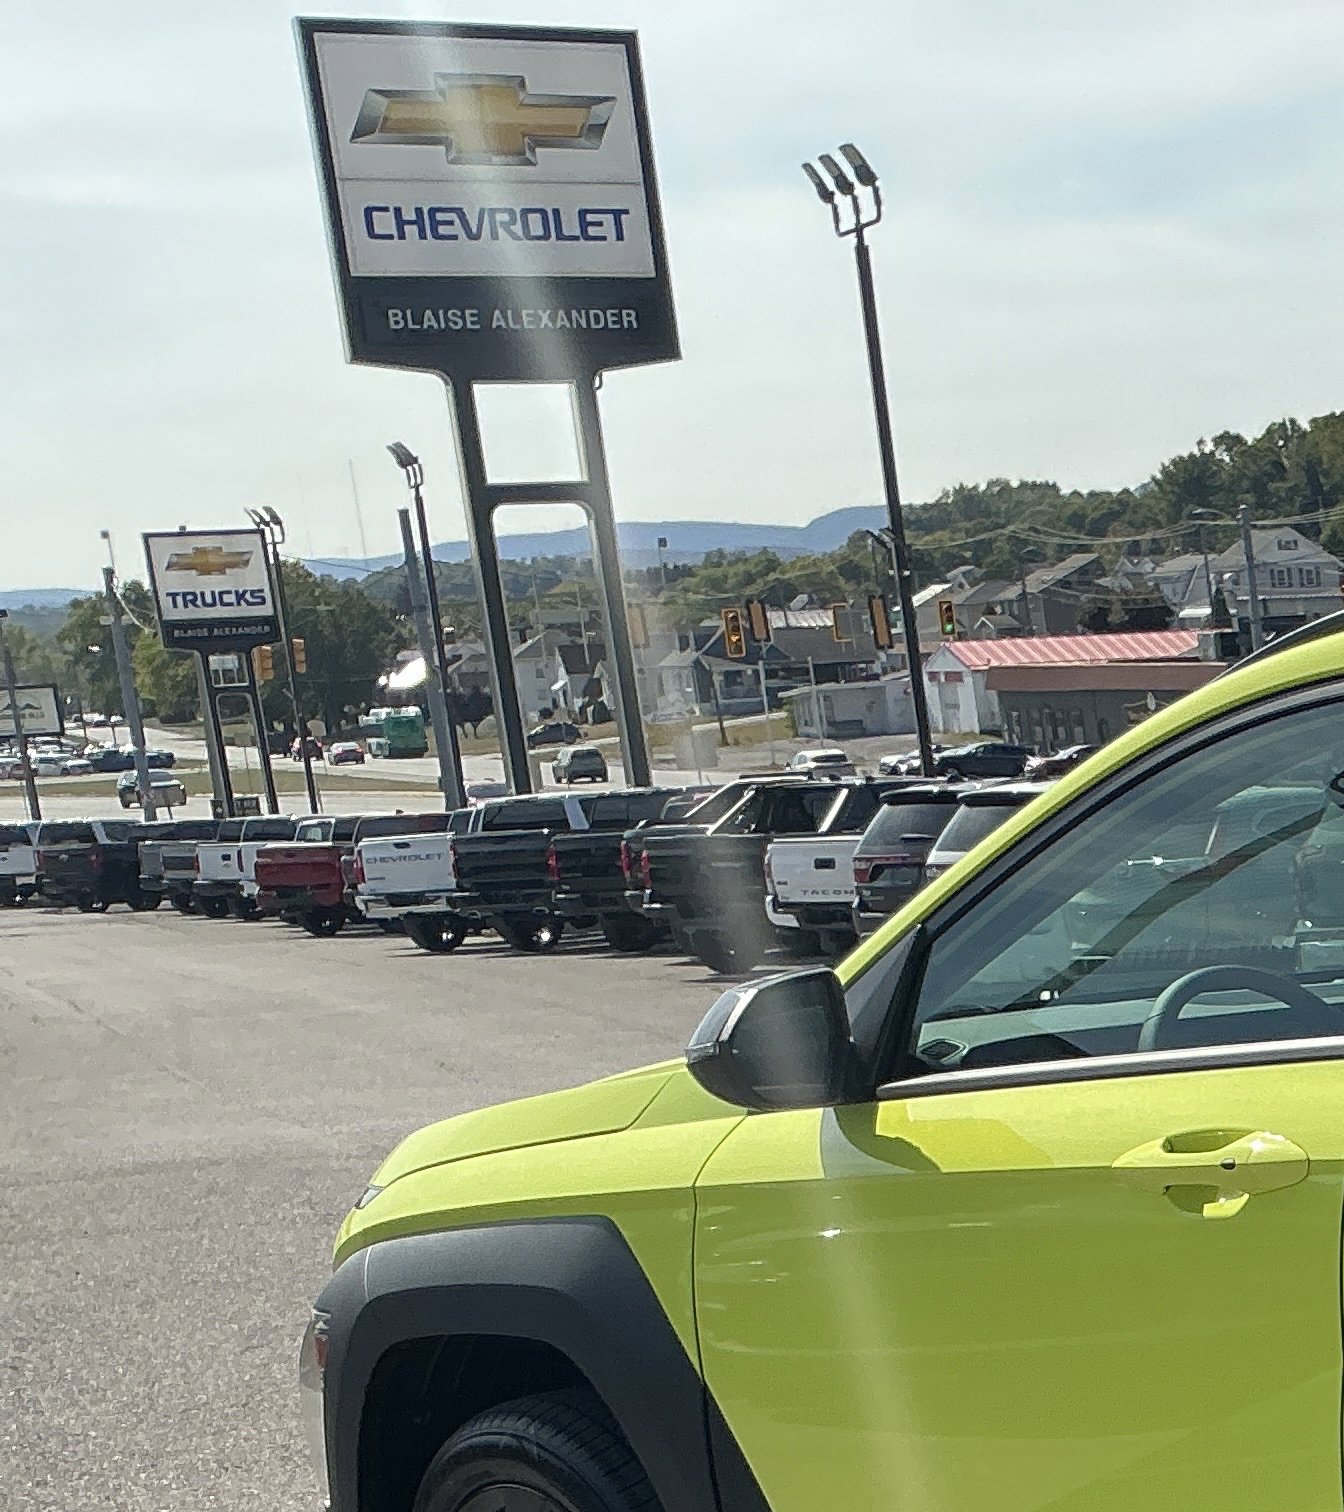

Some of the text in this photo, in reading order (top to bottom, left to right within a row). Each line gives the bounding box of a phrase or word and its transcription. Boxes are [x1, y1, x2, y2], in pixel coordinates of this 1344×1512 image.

[363, 205, 630, 242] CHEVROLET
[387, 308, 638, 330] BLAISE ALEXANDER
[165, 588, 267, 609] TRUCKS
[212, 625, 271, 636] ALEXANDER
[366, 853, 442, 864] CHEVROLET
